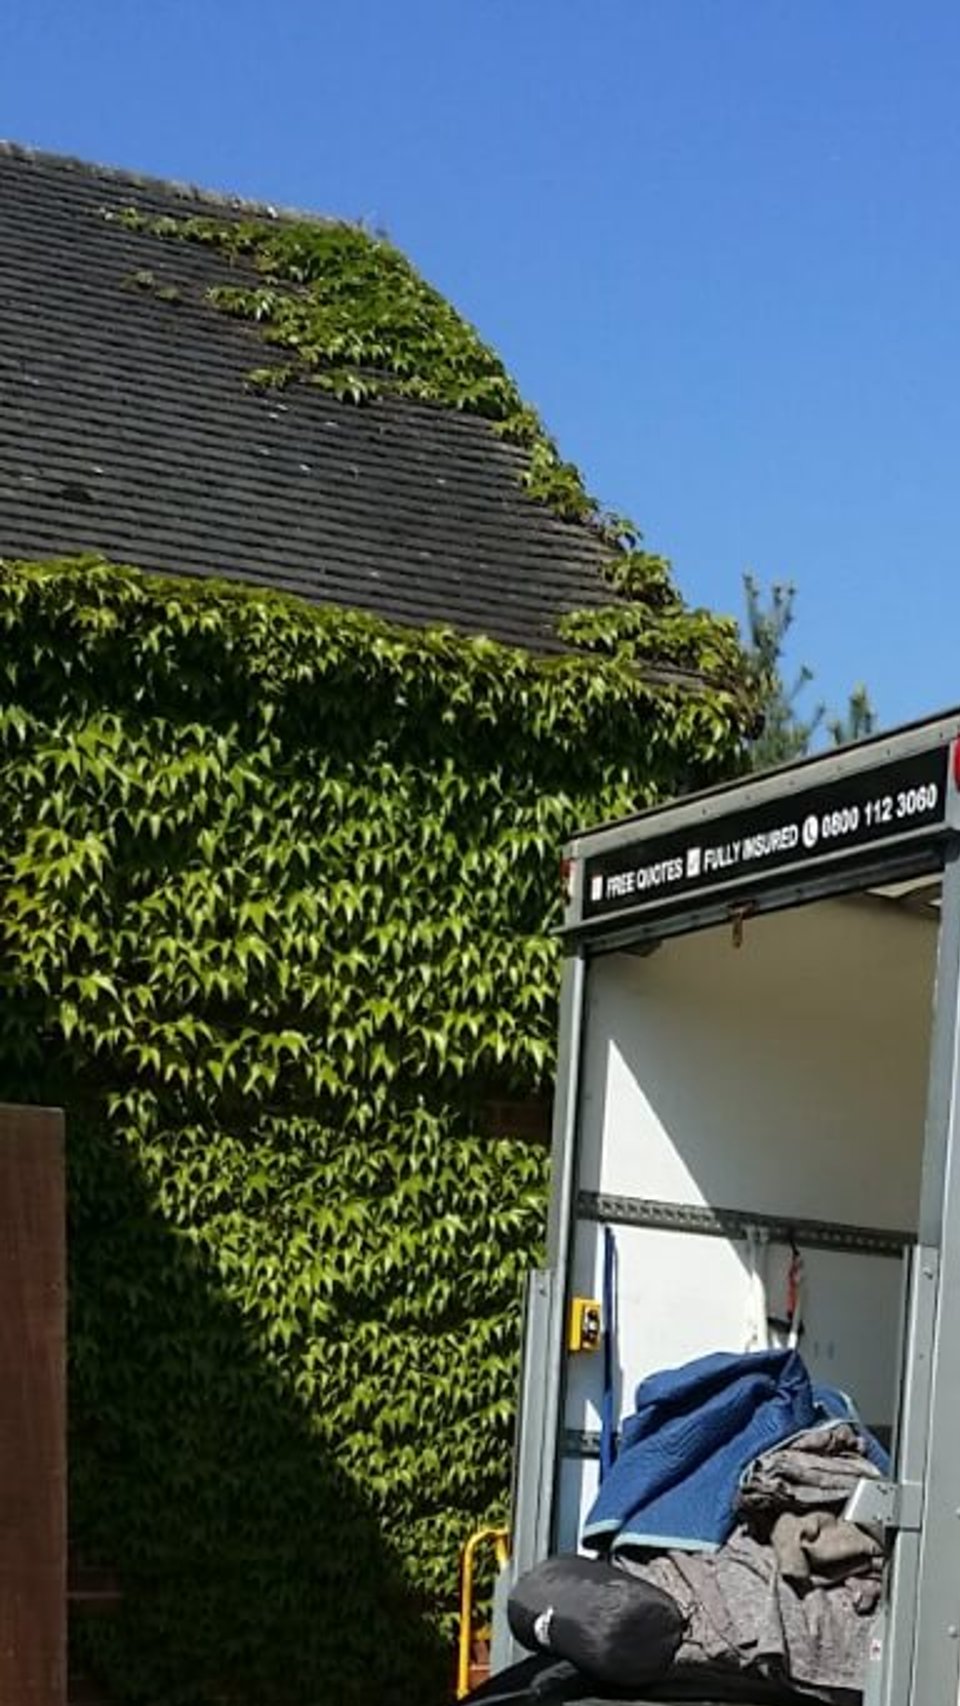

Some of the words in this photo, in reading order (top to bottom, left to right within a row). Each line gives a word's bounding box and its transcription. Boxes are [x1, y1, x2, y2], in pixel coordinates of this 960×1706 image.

[606, 871, 636, 899] FREE
[637, 857, 684, 890] QUOTES
[704, 840, 742, 872] FULLY
[742, 824, 799, 861] INSURED
[821, 806, 859, 839] 0800
[864, 796, 893, 827] 112
[896, 783, 938, 819] 3060
